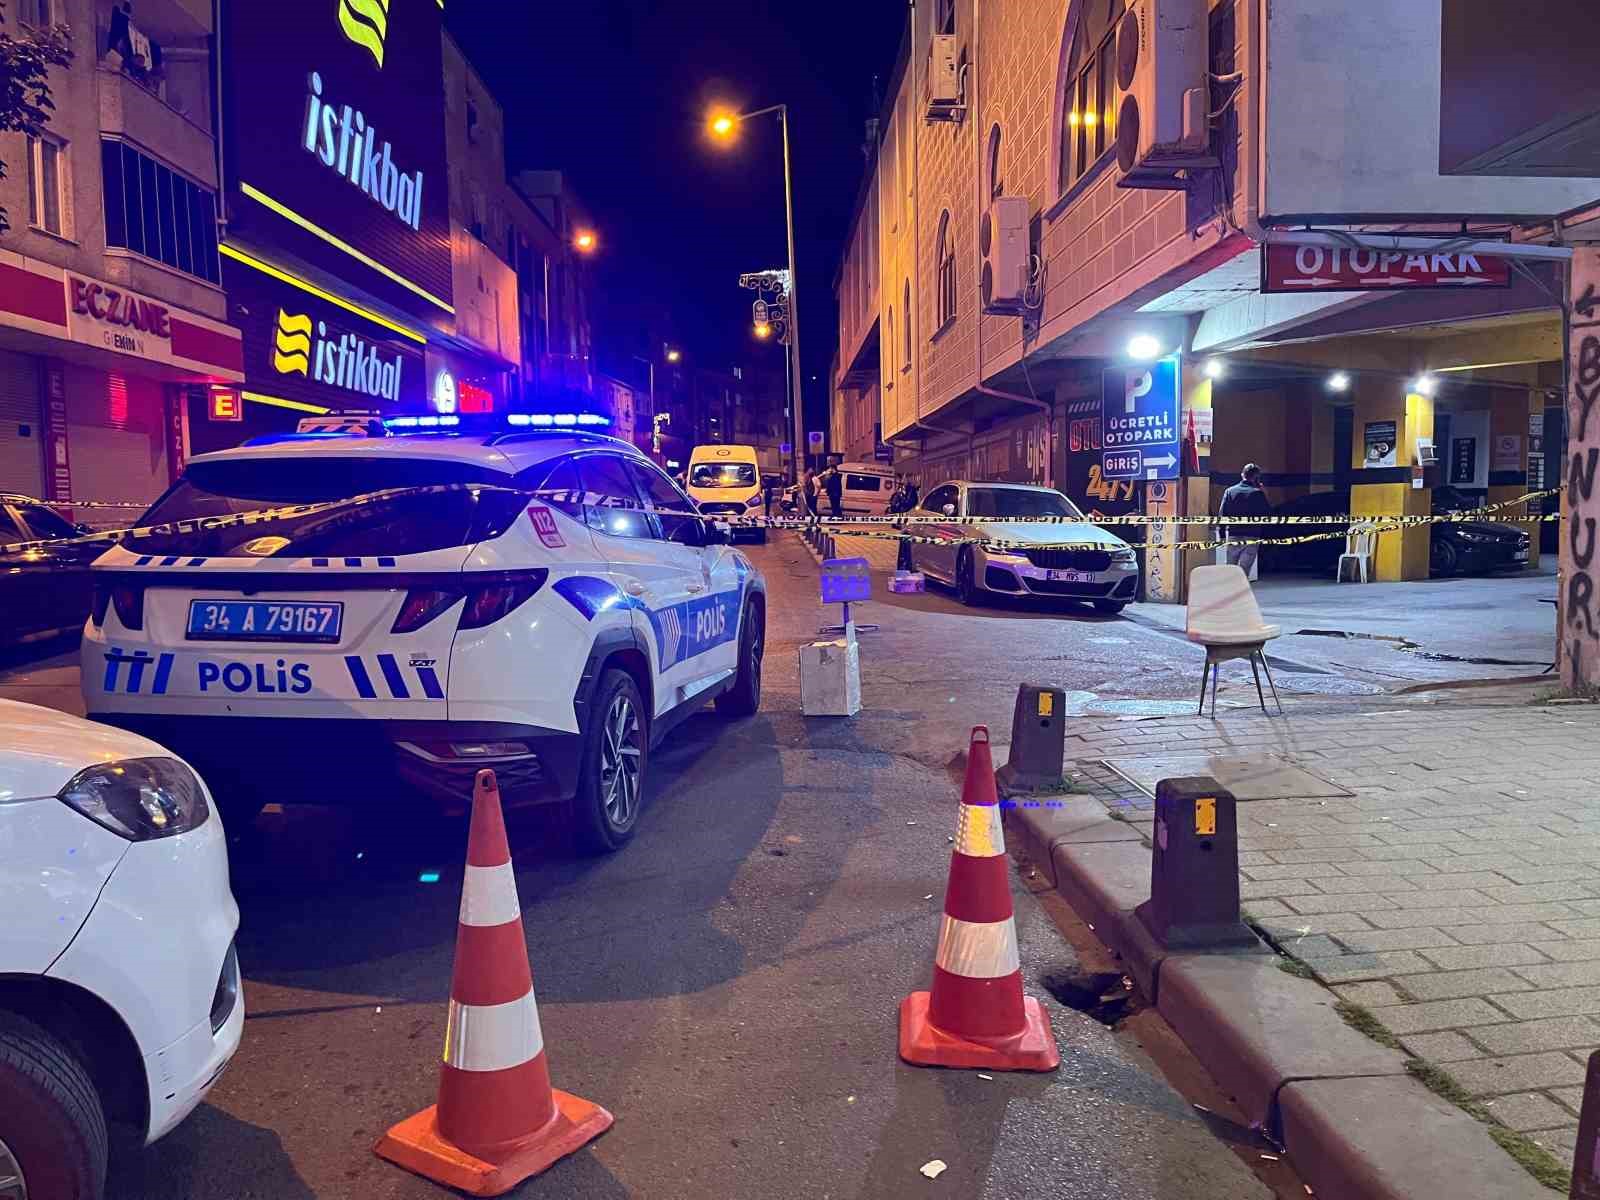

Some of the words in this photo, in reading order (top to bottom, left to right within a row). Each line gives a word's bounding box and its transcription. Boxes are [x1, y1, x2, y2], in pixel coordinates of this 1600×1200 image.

[70, 277, 170, 338] ECZANE
[215, 395, 233, 416] E
[1125, 367, 1153, 414] P
[1106, 428, 1173, 443] OTOPARK
[1110, 410, 1169, 430] ÜCRETLİ
[204, 605, 231, 631] 34
[242, 605, 255, 631] A
[265, 606, 333, 632] 79167
[697, 595, 726, 643] POLİS
[198, 658, 313, 694] POLİS
